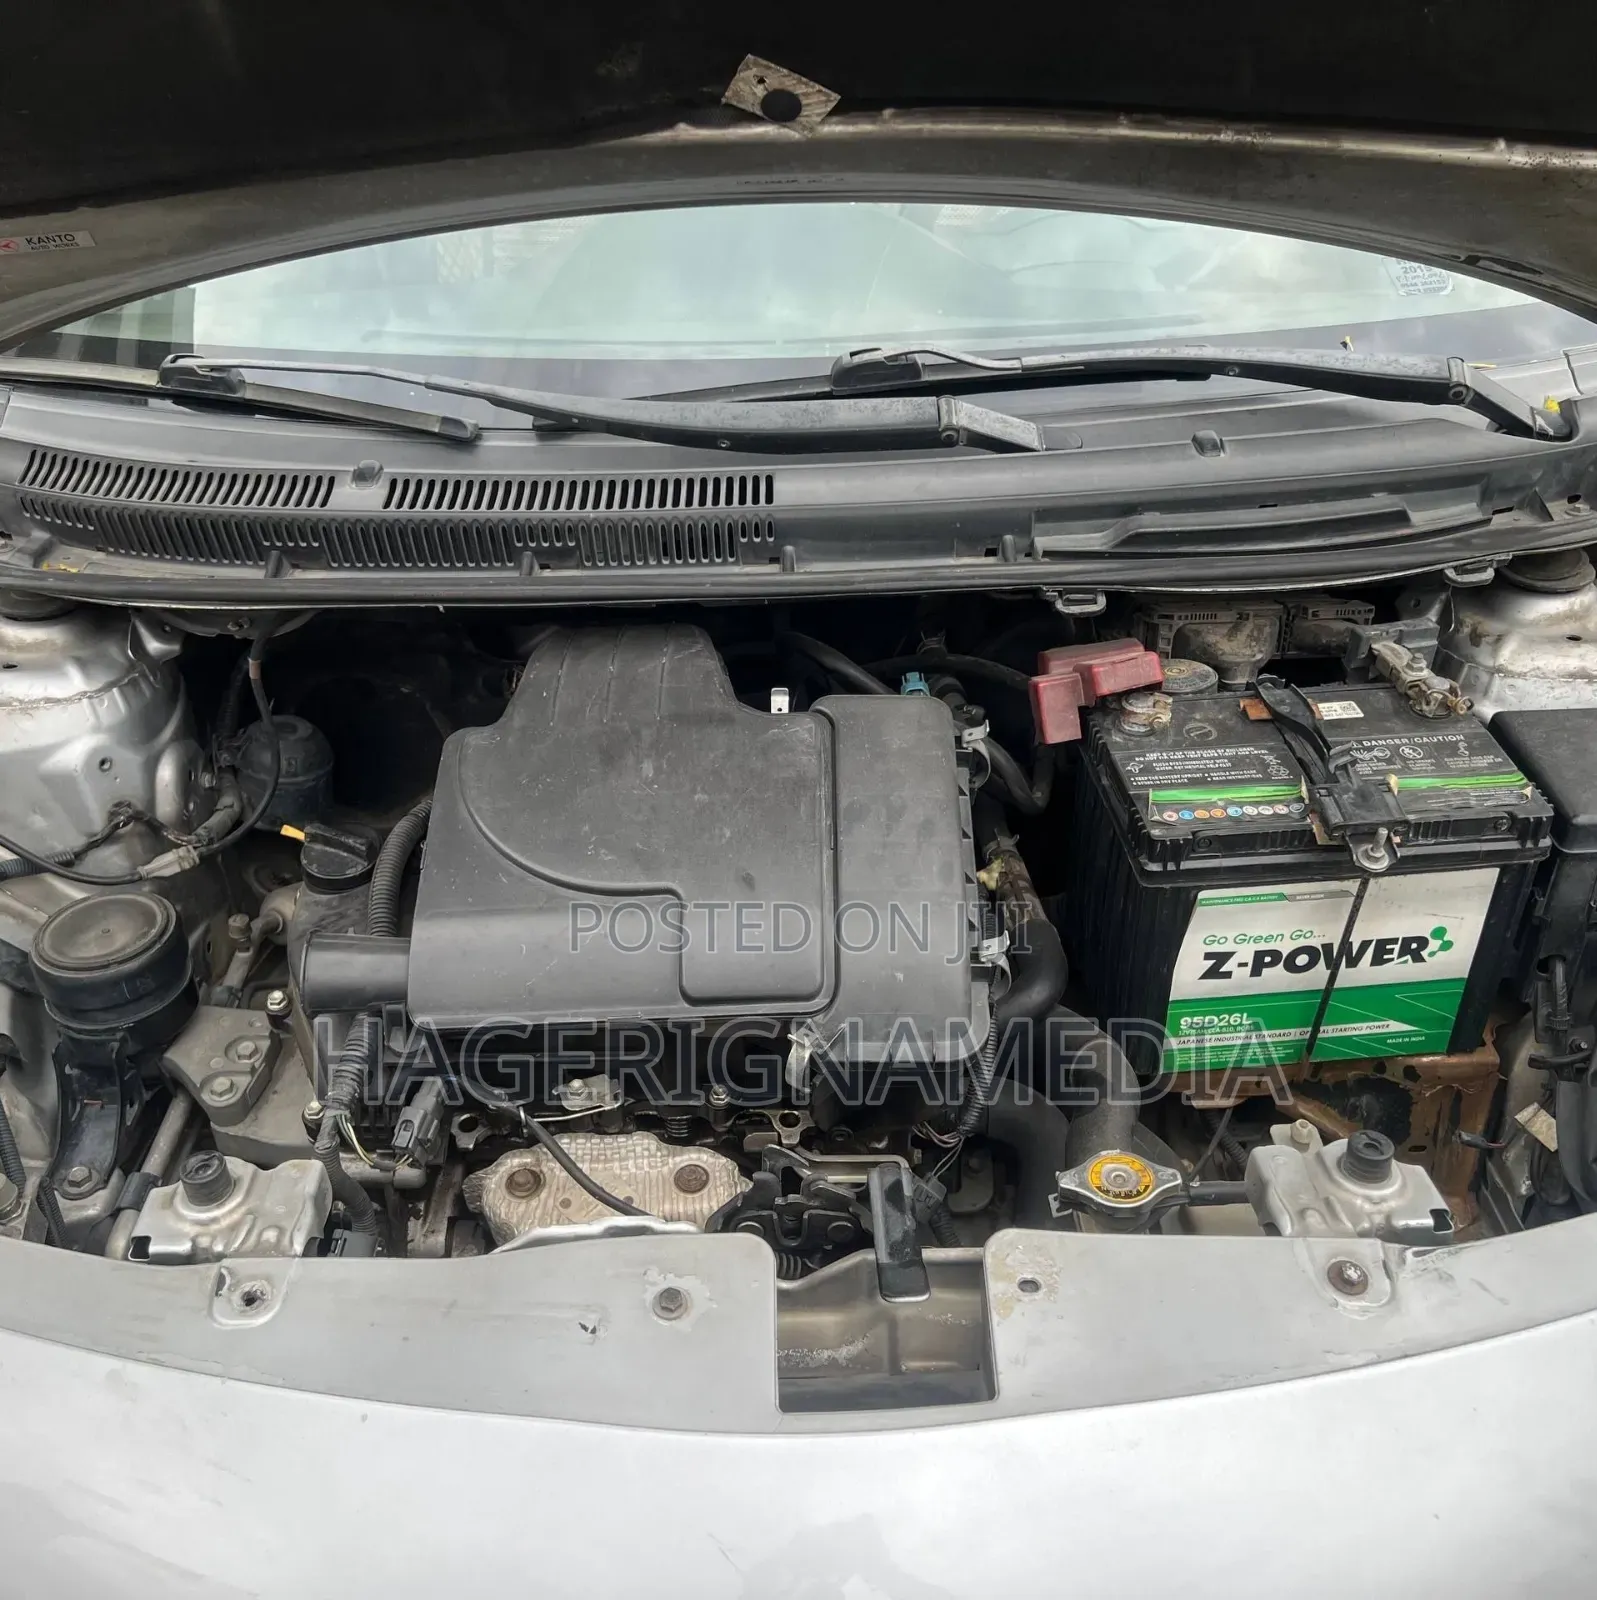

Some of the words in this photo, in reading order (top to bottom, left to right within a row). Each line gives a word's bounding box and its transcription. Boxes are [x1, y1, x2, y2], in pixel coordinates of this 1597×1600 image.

[25, 233, 75, 245] KANTO
[1362, 734, 1465, 747] DANGER/CAUTION
[1203, 934, 1228, 946] Go
[1233, 932, 1284, 946] Green
[1289, 929, 1326, 941] Go...
[1197, 935, 1429, 980] Z-POWER
[1180, 1012, 1253, 1029] 95D26L
[1176, 1037, 1212, 1046] JAPANESE
[1213, 1034, 1253, 1043] INDUSTRIAL
[1254, 1031, 1292, 1041] STANDARD
[1330, 1025, 1364, 1034] STARTING
[1365, 1023, 1391, 1031] POWER
